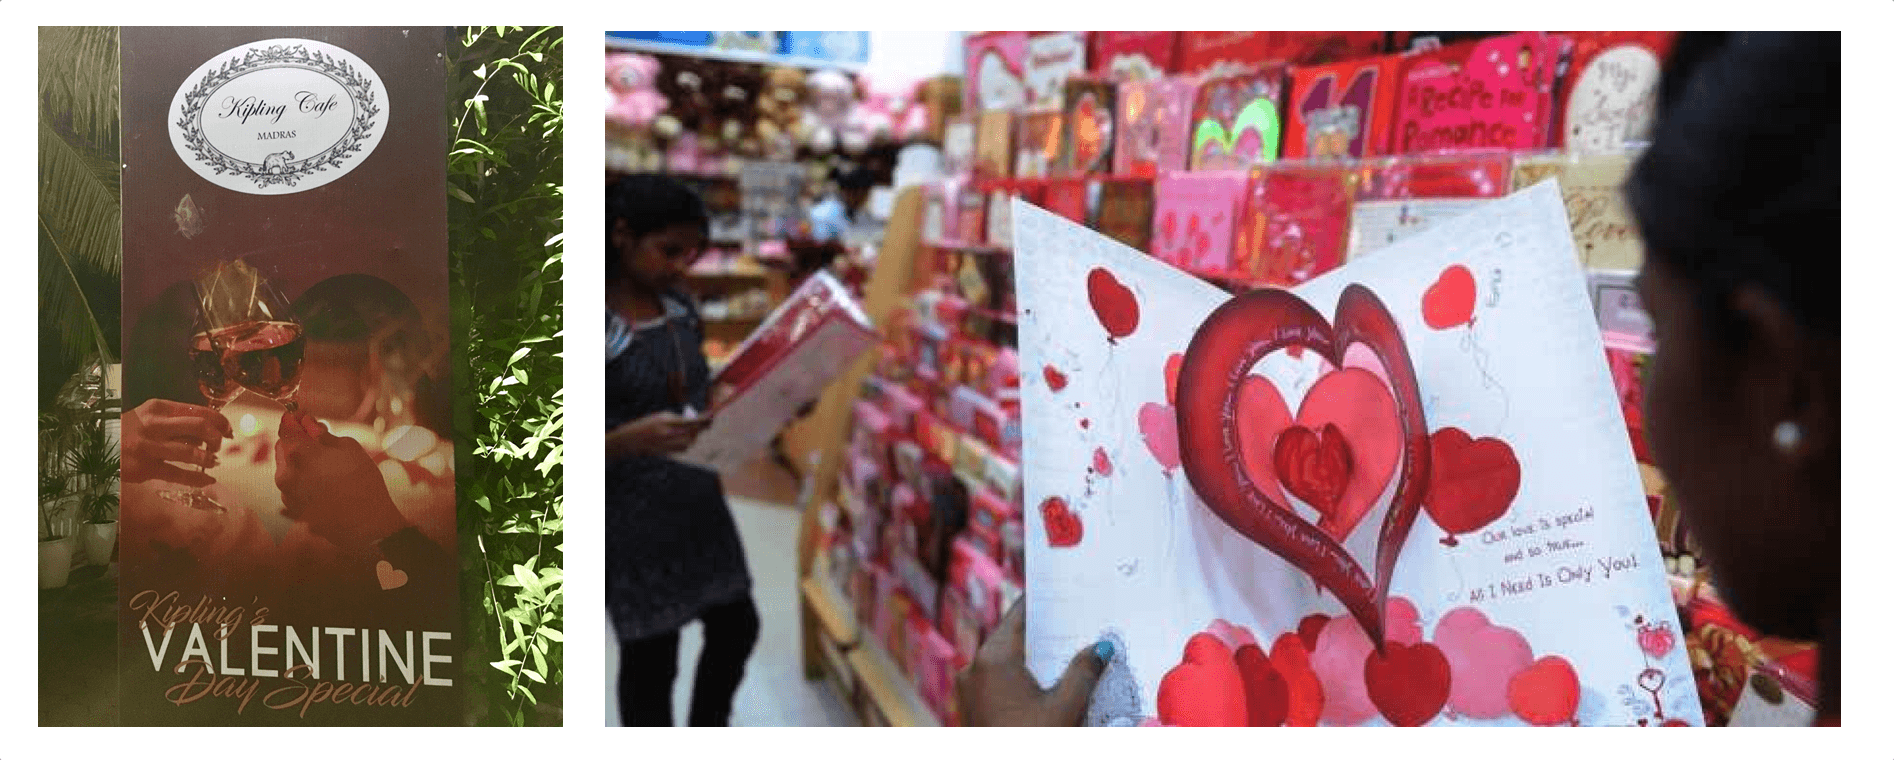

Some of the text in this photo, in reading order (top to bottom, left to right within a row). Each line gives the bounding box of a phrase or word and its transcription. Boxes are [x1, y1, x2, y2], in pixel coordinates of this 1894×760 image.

[218, 90, 338, 125] Kipling Cafe
[257, 130, 297, 140] MADRAS
[1488, 584, 1497, 598] I
[129, 589, 270, 641] Kipling's
[139, 620, 453, 687] VALENTINE
[165, 659, 424, 719] Day Special
